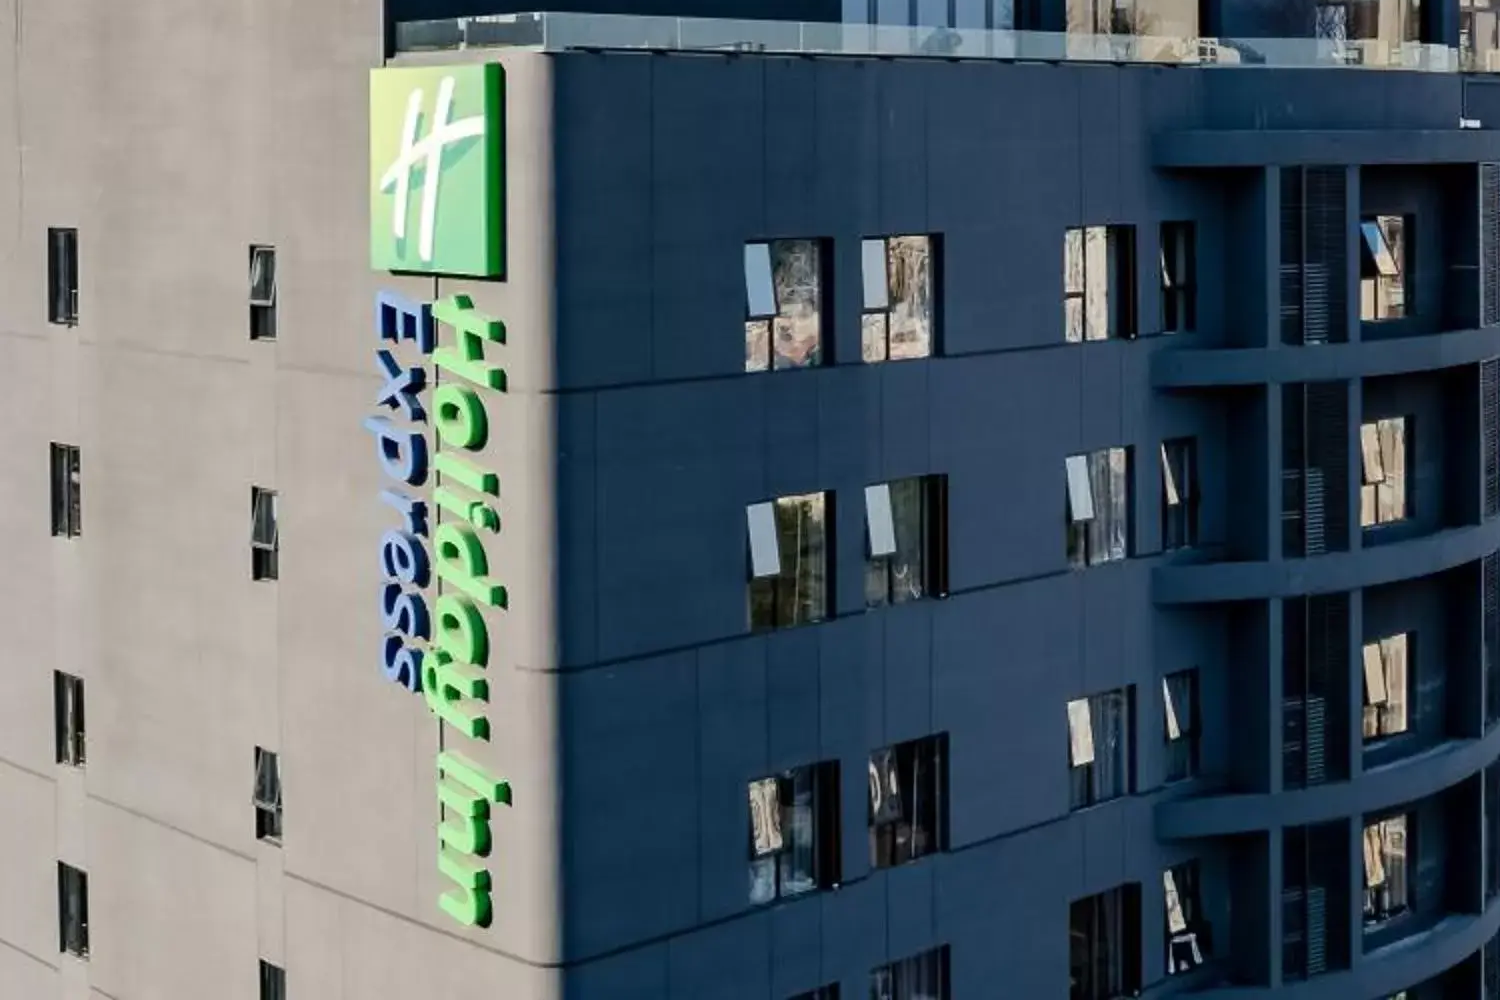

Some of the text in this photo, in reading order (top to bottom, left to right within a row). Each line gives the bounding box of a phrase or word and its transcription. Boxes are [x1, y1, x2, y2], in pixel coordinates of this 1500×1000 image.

[364, 290, 434, 693] Express
[421, 293, 512, 929] Holiday Inn
